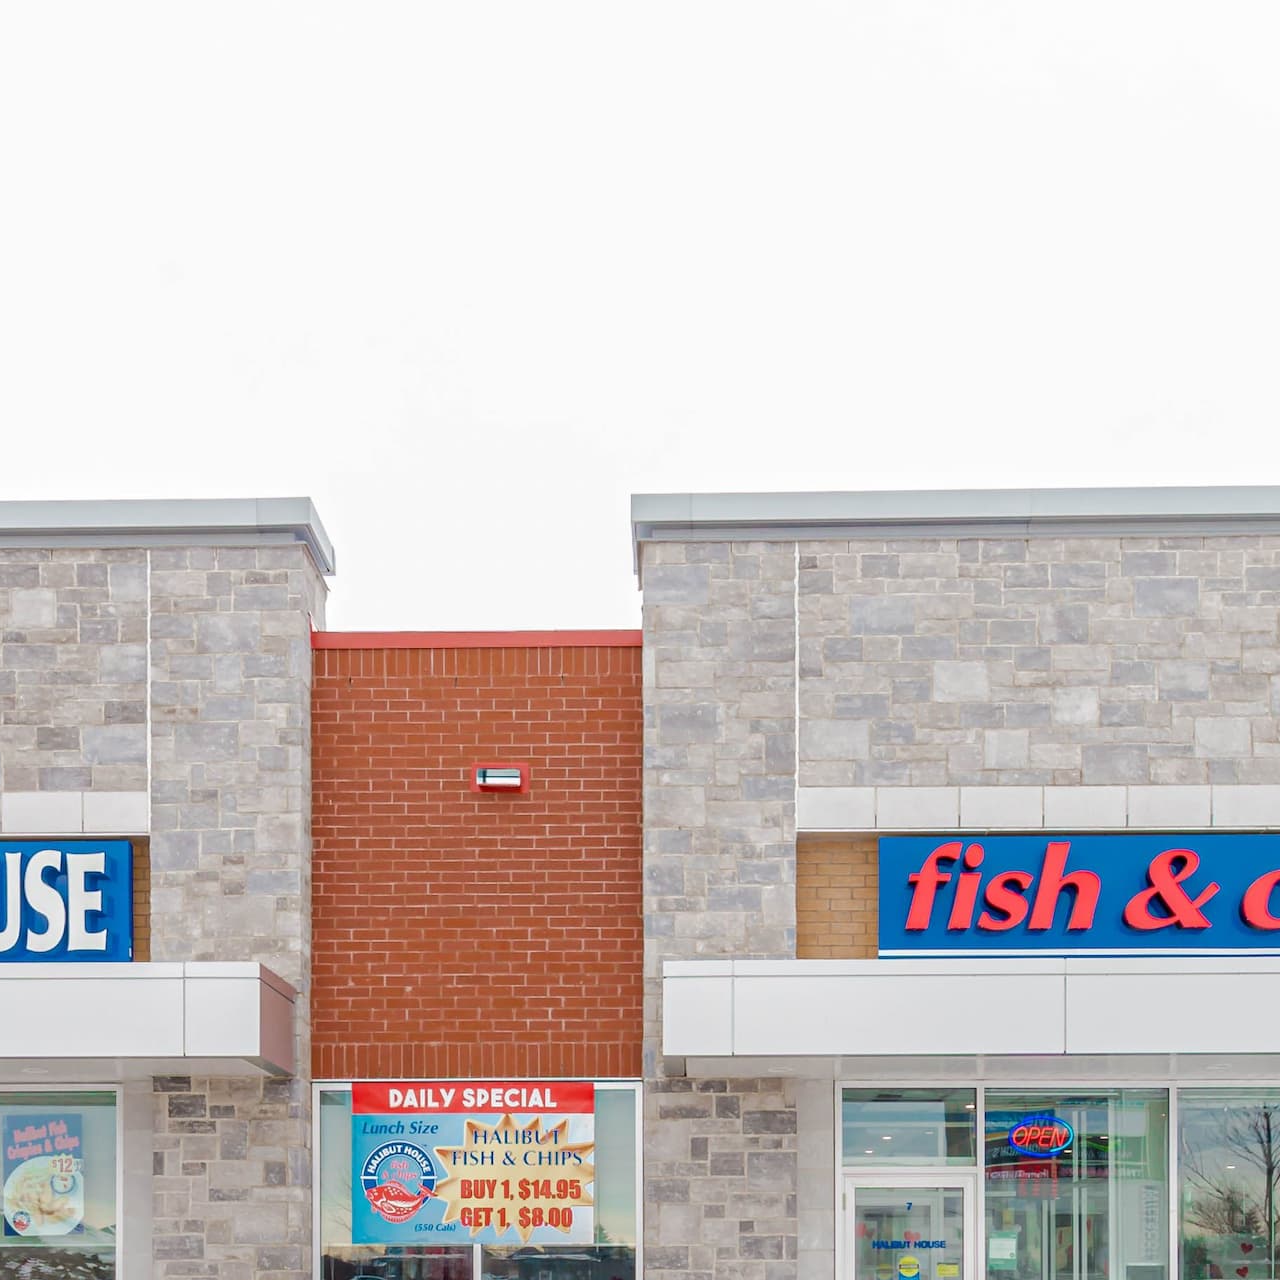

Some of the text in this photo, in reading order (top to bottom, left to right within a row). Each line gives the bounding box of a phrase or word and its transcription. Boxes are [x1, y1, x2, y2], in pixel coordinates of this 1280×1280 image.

[905, 841, 1101, 930] fish
[1124, 848, 1220, 929] &
[388, 1087, 557, 1109] DAILY SPECIAL
[362, 1121, 439, 1135] Lunch Size
[473, 1128, 560, 1145] HALIBUT
[1012, 1126, 1068, 1148] OPEN
[367, 1145, 431, 1173] HALIBUT HOUSE
[452, 1150, 583, 1166] FISH & CHIPS
[460, 1179, 582, 1201] BUY 1, $14.95
[906, 1202, 913, 1211] 7
[460, 1206, 573, 1229] GET 1, $8.00
[414, 1223, 434, 1233] (550
[872, 1240, 946, 1249] HALIBUT HOUSE
